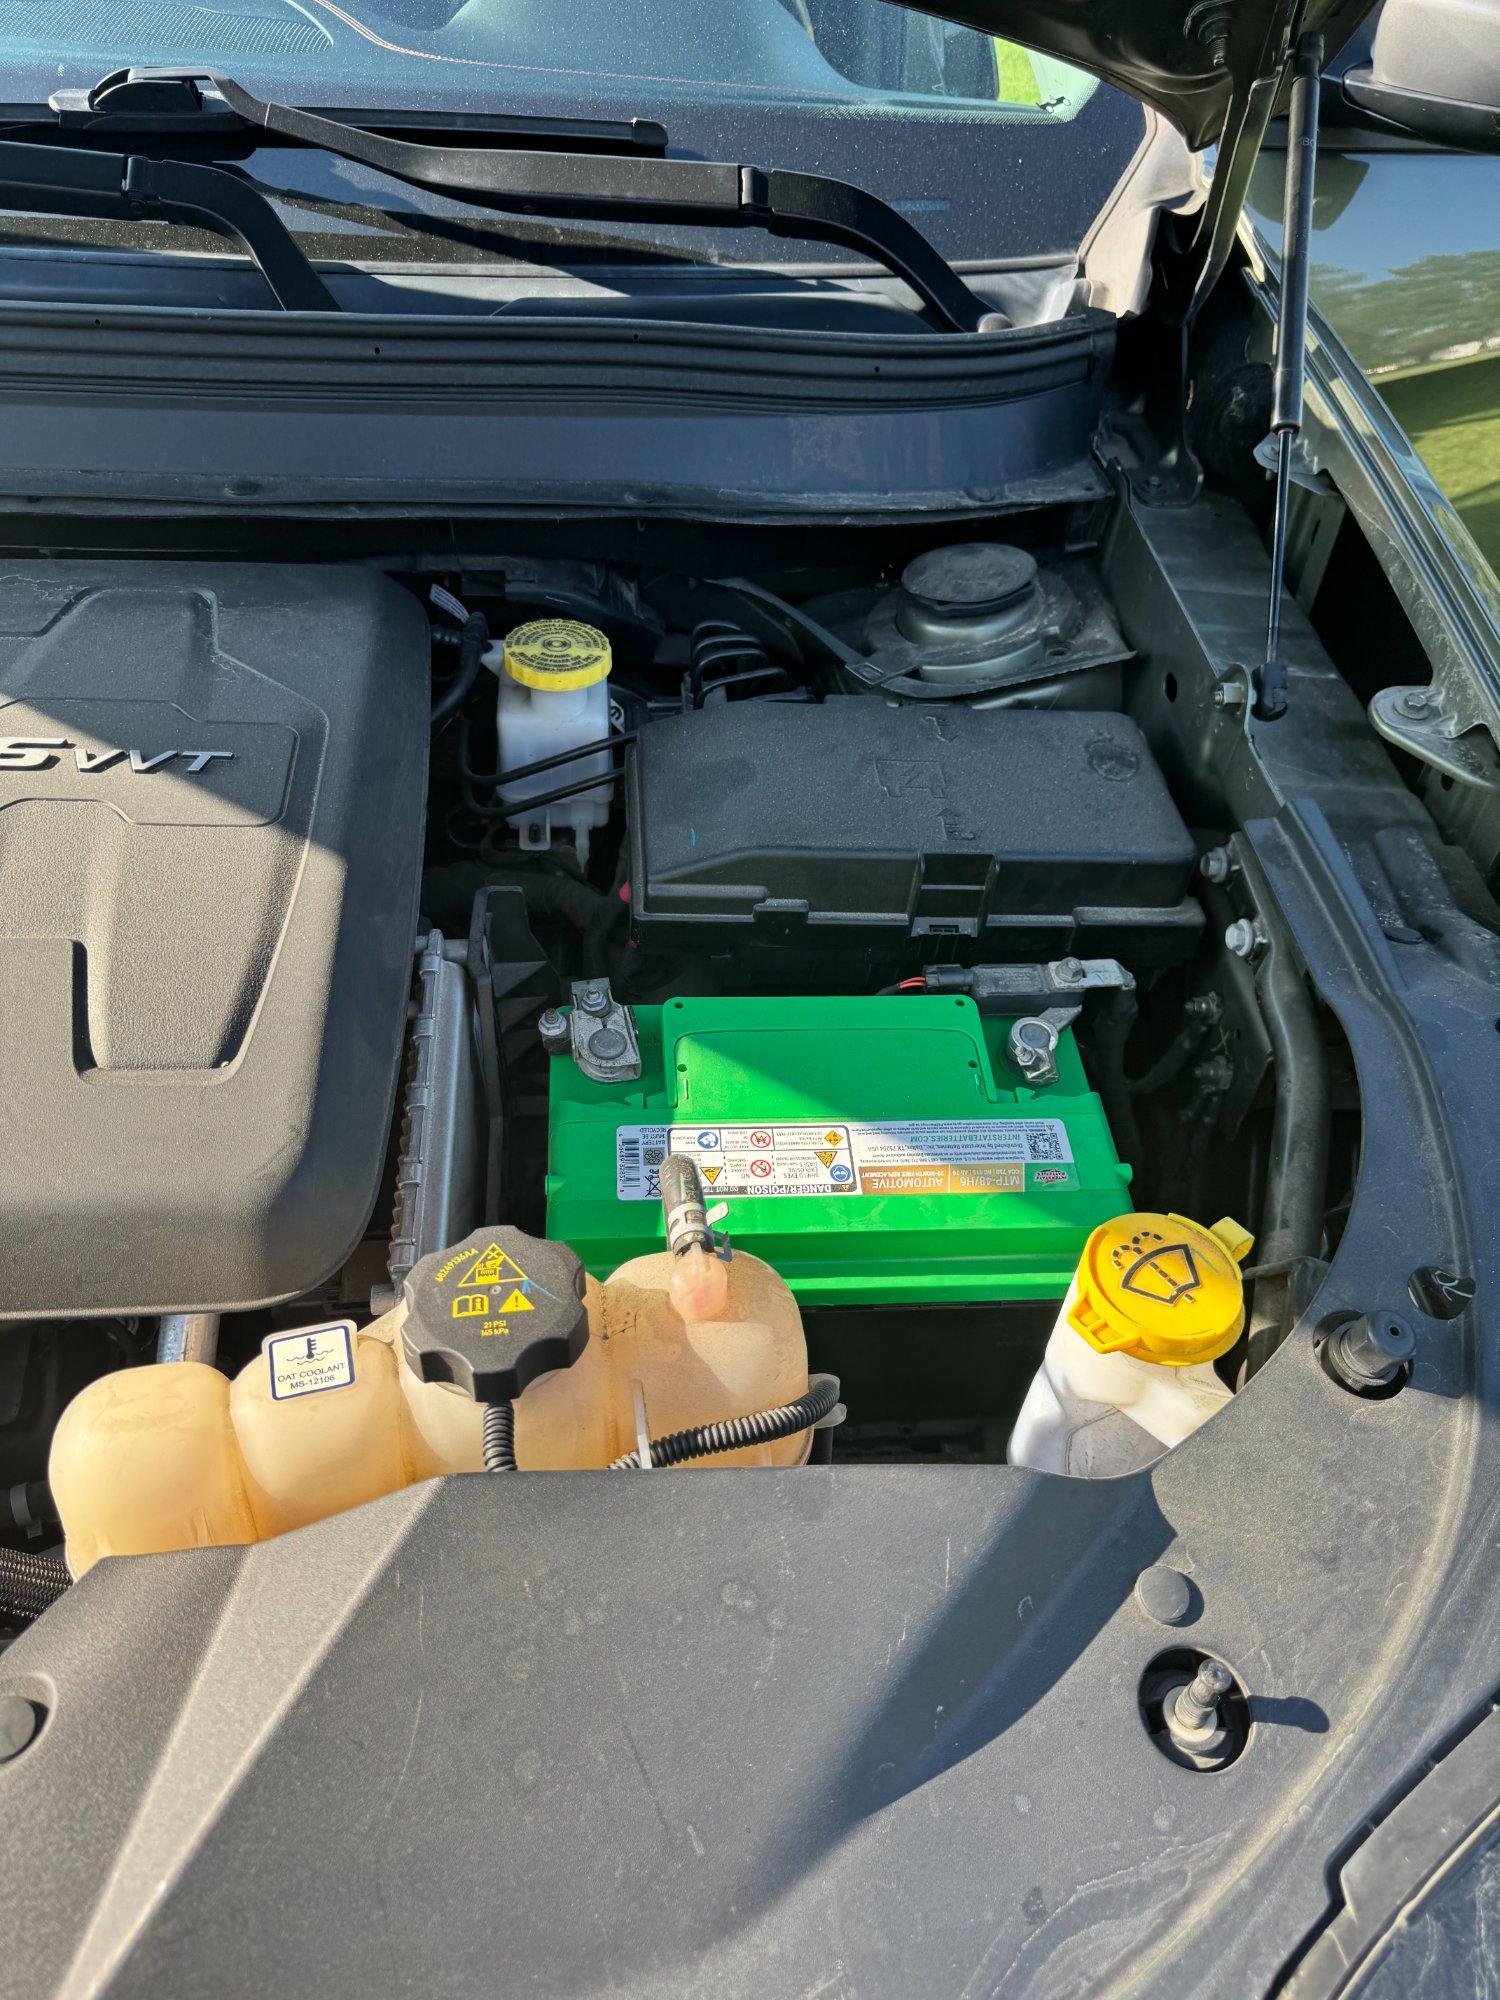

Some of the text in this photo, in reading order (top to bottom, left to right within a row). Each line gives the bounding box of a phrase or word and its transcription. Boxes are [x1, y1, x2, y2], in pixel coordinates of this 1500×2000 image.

[75, 749, 234, 774] VVT
[910, 1134, 1020, 1142] INTERSTATEBATTERIES.COM
[872, 1177, 943, 1189] AUTOMOTIVE
[960, 1176, 1020, 1187] MTP-48/H6
[747, 1184, 832, 1194] DANGER/POISON
[484, 1319, 507, 1329] 21 PSI
[494, 1327, 509, 1336] kPa
[277, 1362, 345, 1383] OAT COOLANT
[290, 1374, 335, 1390] MS-12106
